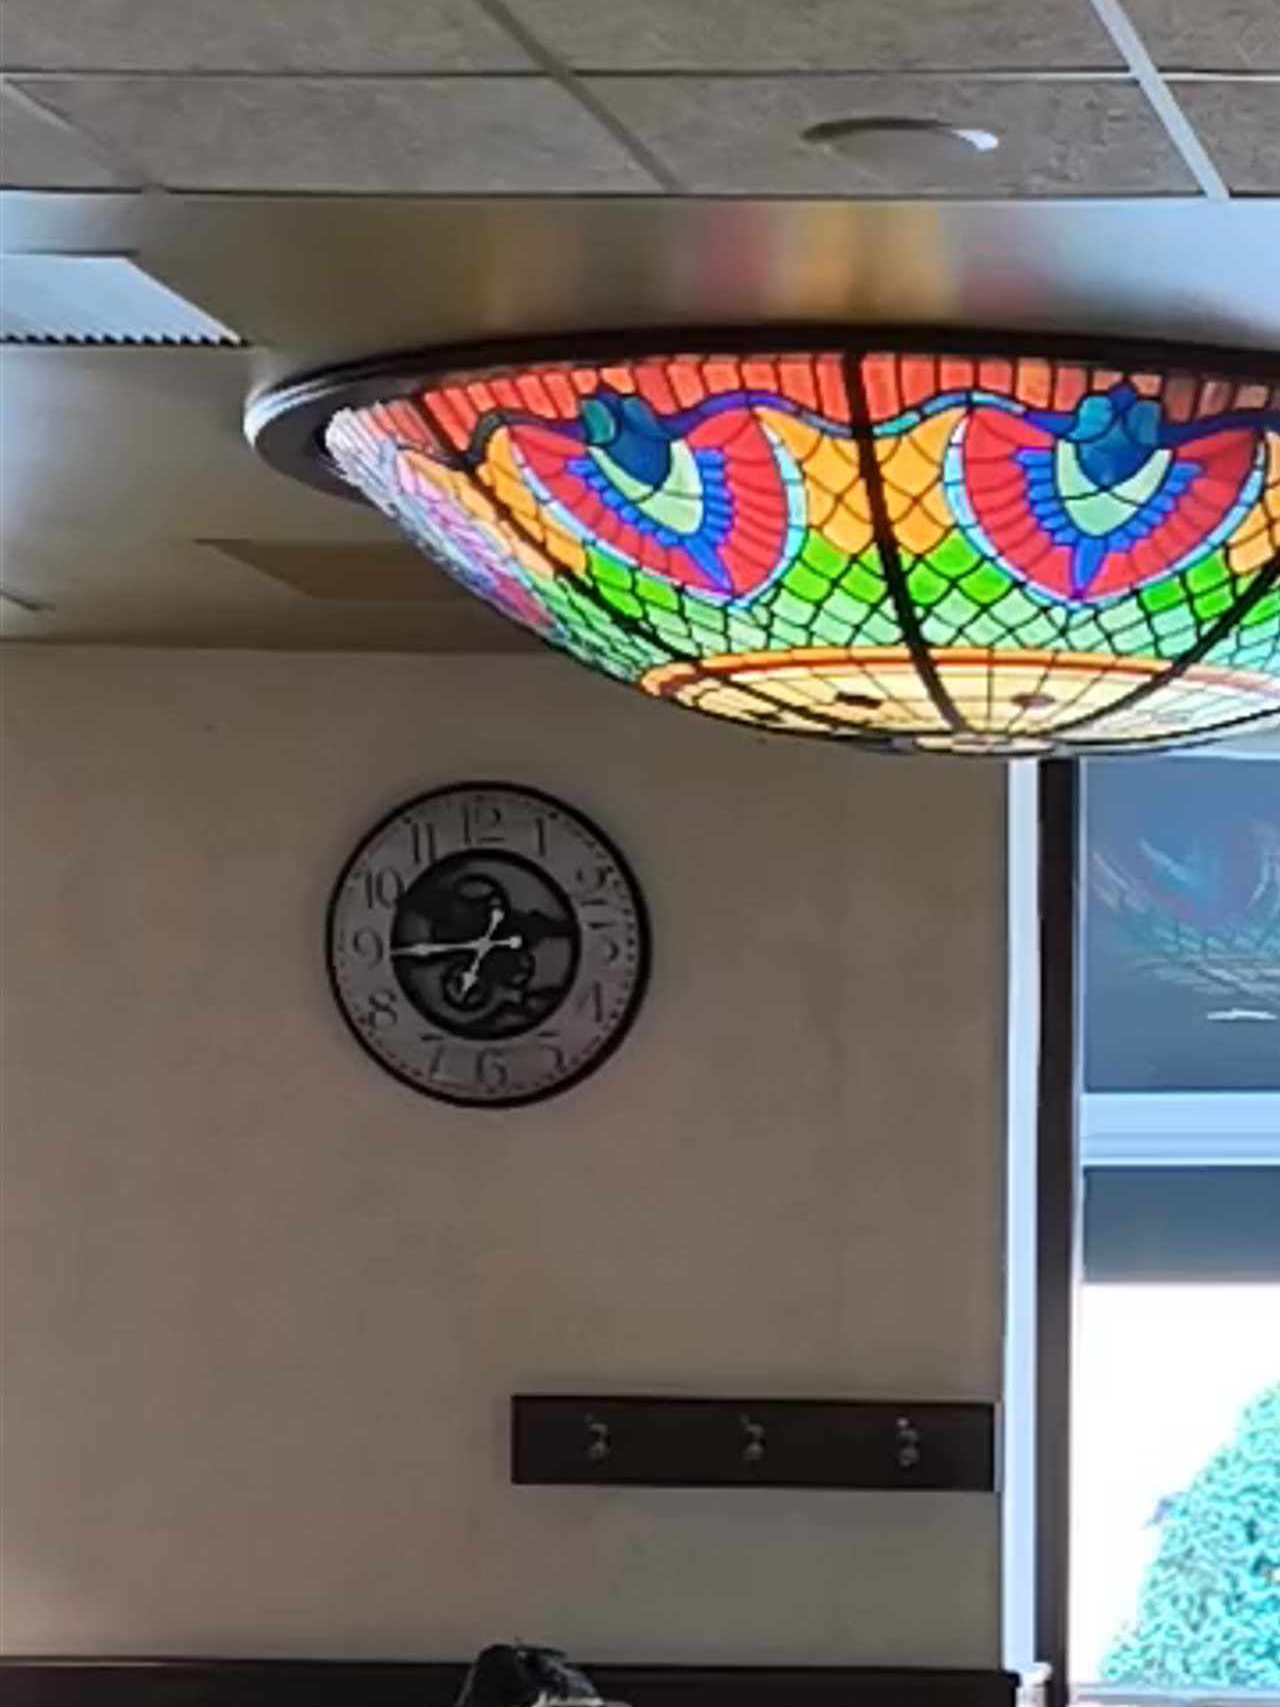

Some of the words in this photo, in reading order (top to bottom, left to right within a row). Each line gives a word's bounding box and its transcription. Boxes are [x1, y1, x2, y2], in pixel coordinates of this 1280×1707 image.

[411, 822, 436, 864] 11
[462, 804, 504, 846] 12
[363, 868, 403, 909] 10
[353, 928, 384, 967] 9
[367, 990, 398, 1029] 8
[475, 1047, 507, 1086] 6
